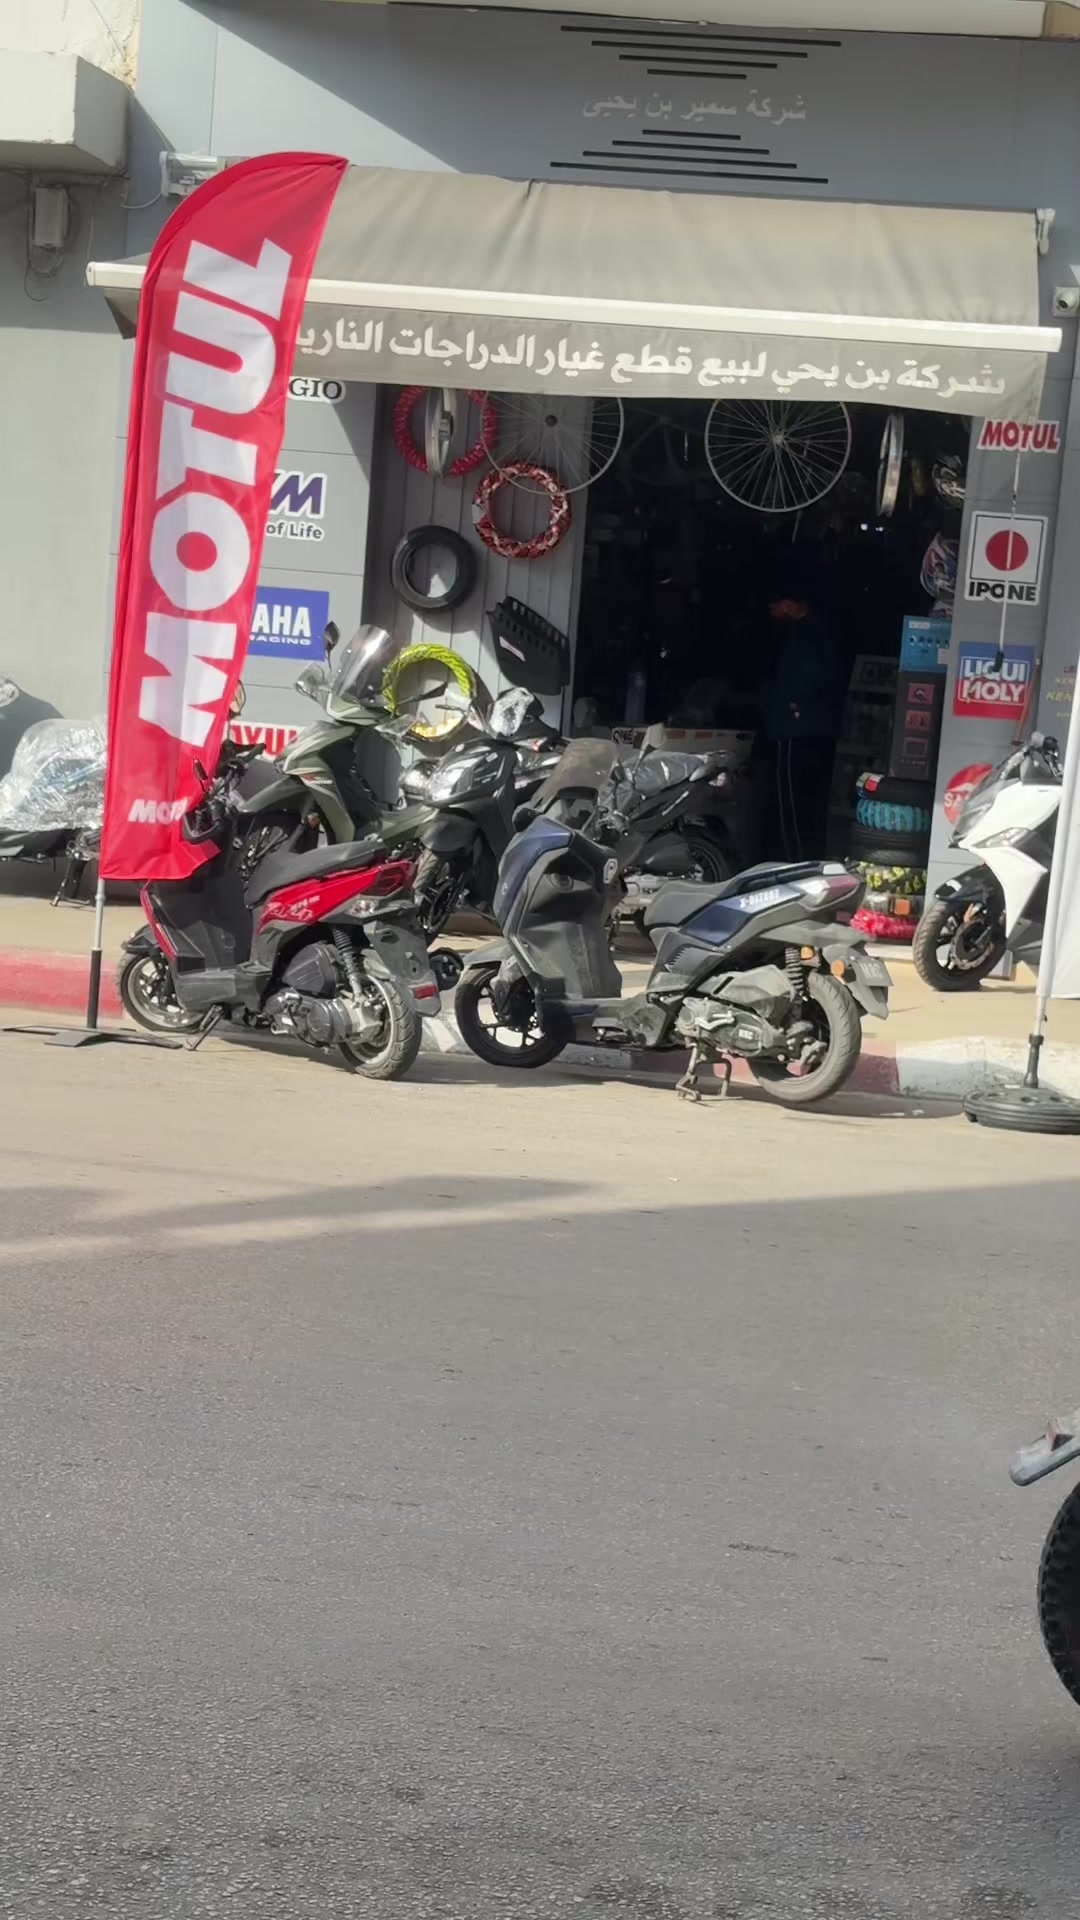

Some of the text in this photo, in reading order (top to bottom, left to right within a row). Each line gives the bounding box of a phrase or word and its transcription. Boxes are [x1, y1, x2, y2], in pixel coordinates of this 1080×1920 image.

[645, 92, 673, 120] بن
[746, 88, 807, 126] شركة
[295, 317, 384, 357] الناري
[388, 325, 536, 371] الدراجات
[535, 337, 606, 377] غيار
[610, 344, 692, 384] قطع
[697, 350, 768, 387] لبيع
[845, 360, 891, 391] بن
[895, 359, 1006, 398] شركة
[981, 420, 1059, 450] MOTUL
[138, 237, 293, 748] MOTUL
[289, 523, 322, 540] Life
[968, 581, 1037, 601] IPONE
[964, 659, 1026, 682] LIQUI
[962, 680, 1025, 703] MOLY
